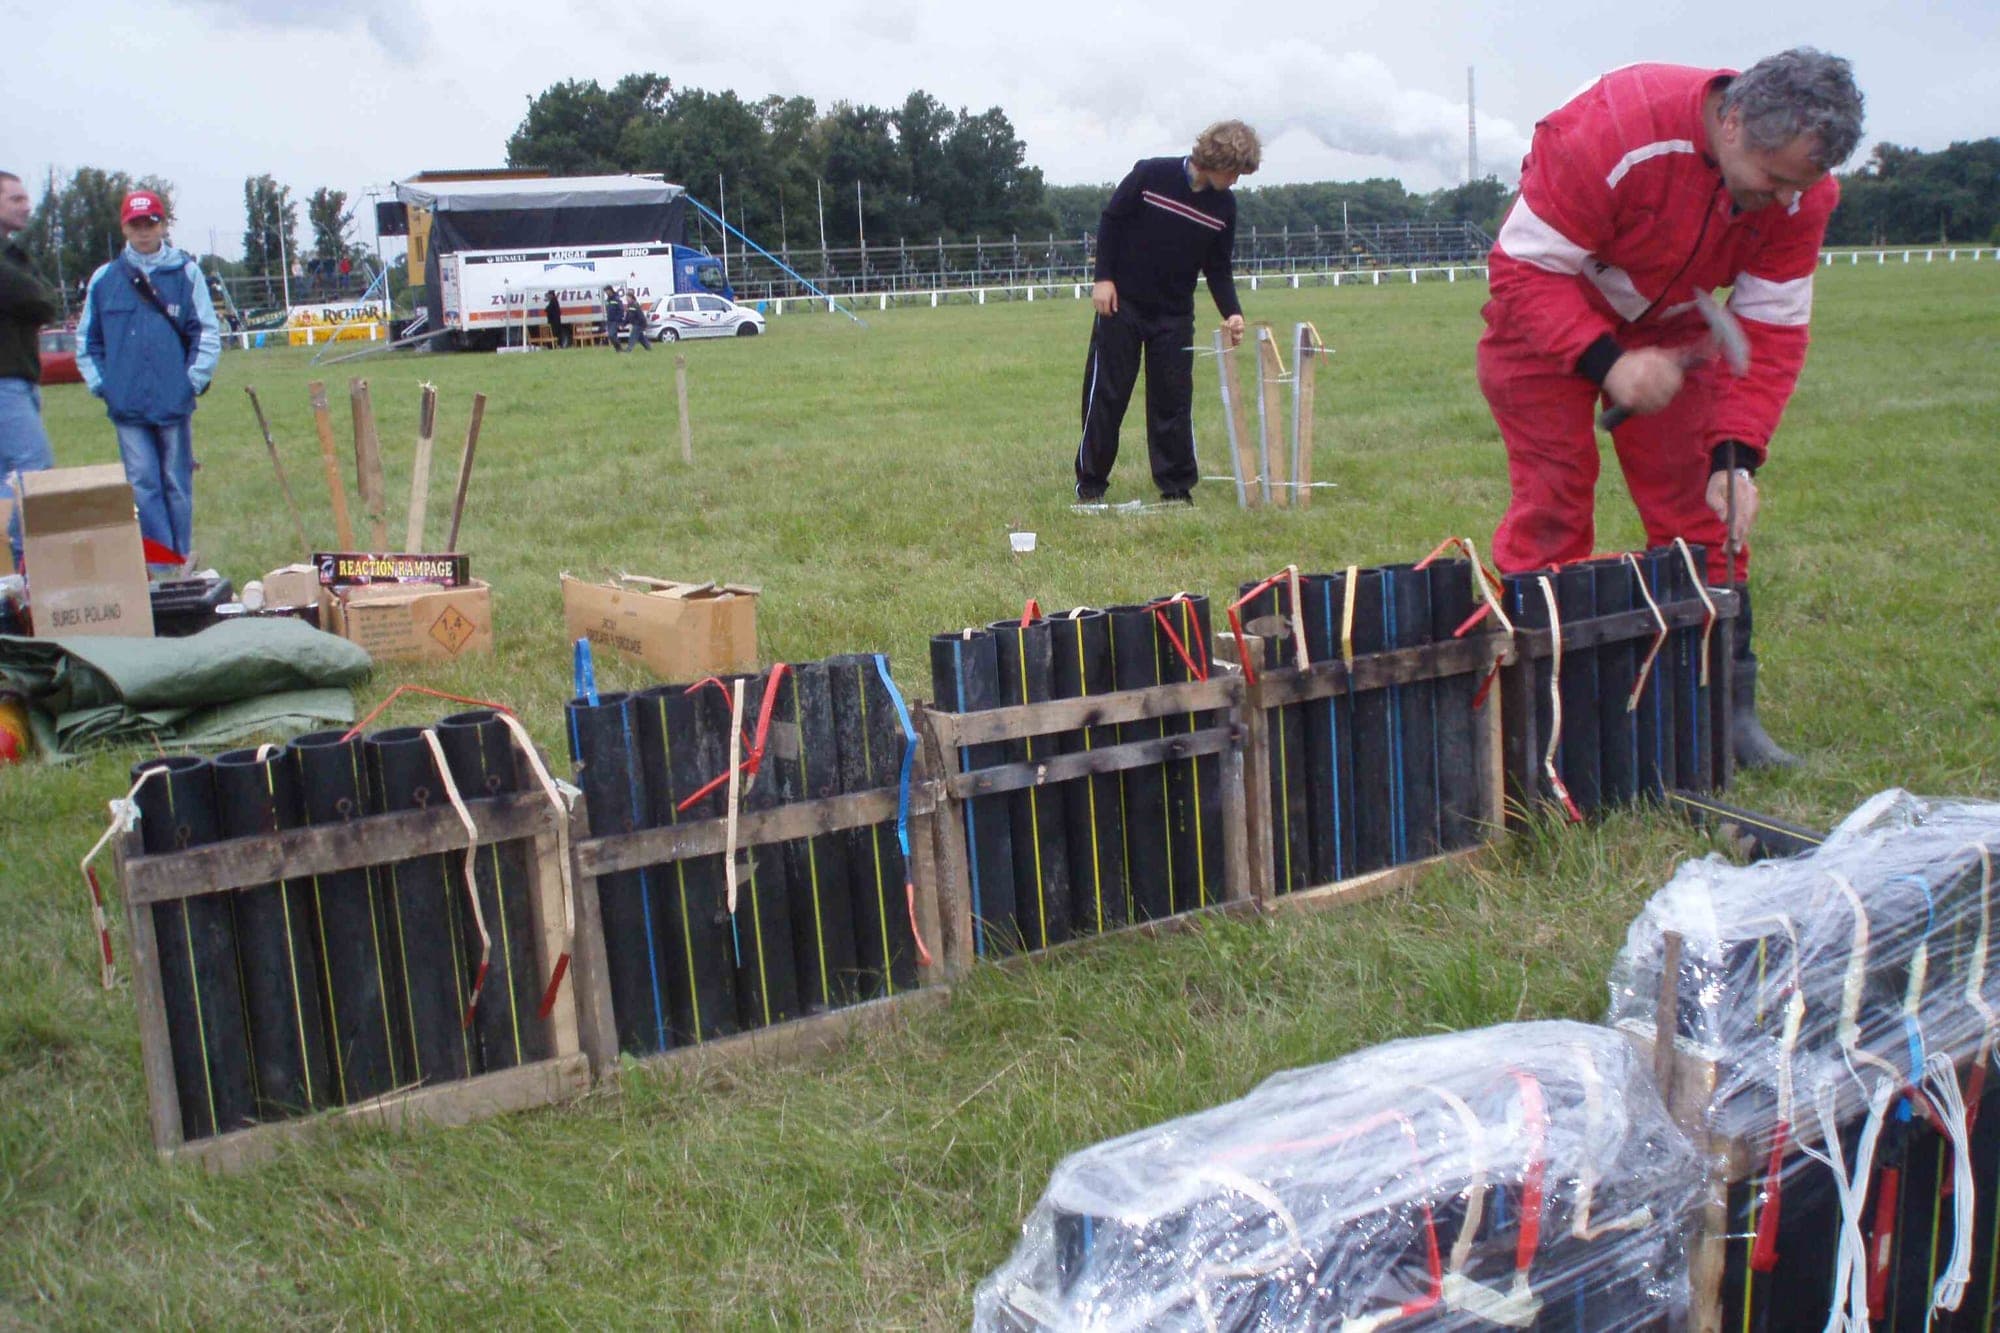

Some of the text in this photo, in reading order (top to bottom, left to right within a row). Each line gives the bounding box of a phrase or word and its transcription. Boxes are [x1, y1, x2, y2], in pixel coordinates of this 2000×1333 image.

[622, 248, 649, 257] BRNO
[339, 560, 394, 577] REACTION
[398, 560, 453, 577] RAMPAGE
